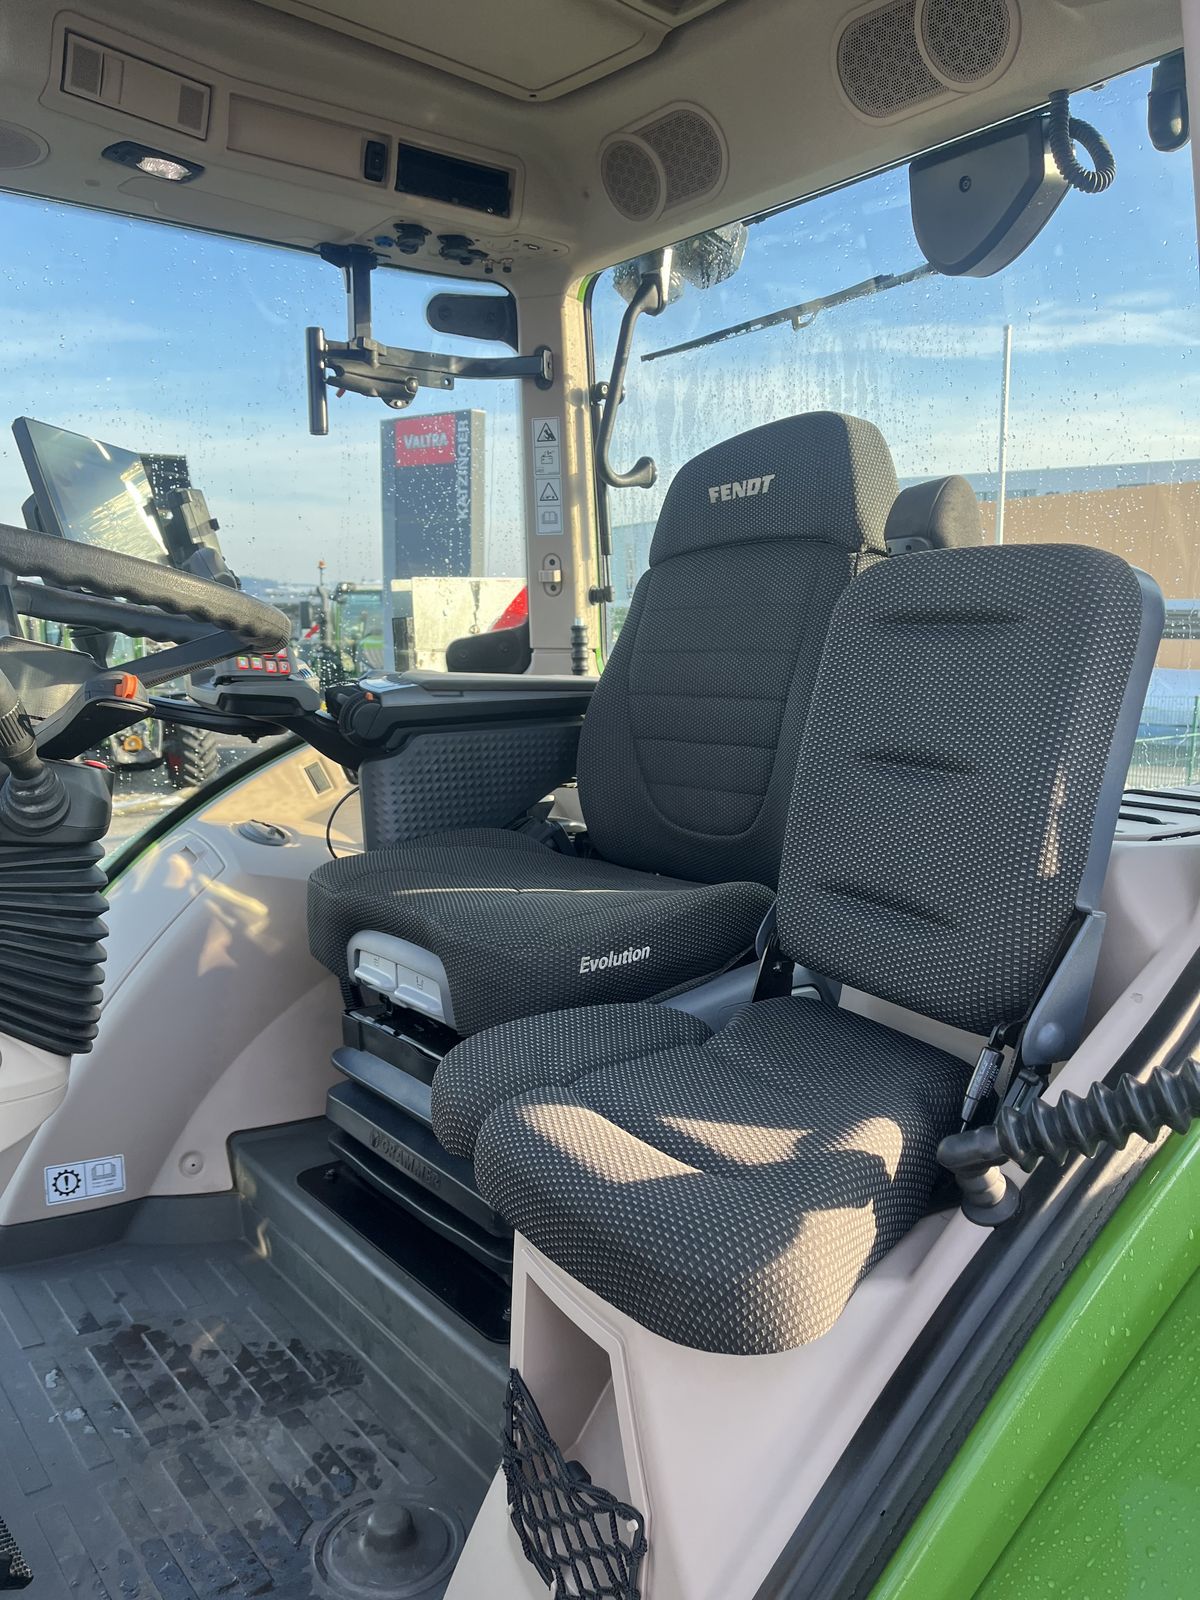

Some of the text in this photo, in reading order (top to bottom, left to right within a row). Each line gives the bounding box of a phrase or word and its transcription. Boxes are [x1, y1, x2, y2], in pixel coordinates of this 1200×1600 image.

[403, 432, 449, 449] VALTRA
[457, 419, 469, 519] KATZINGER
[708, 473, 776, 503] FENDT
[580, 946, 651, 973] Evolution
